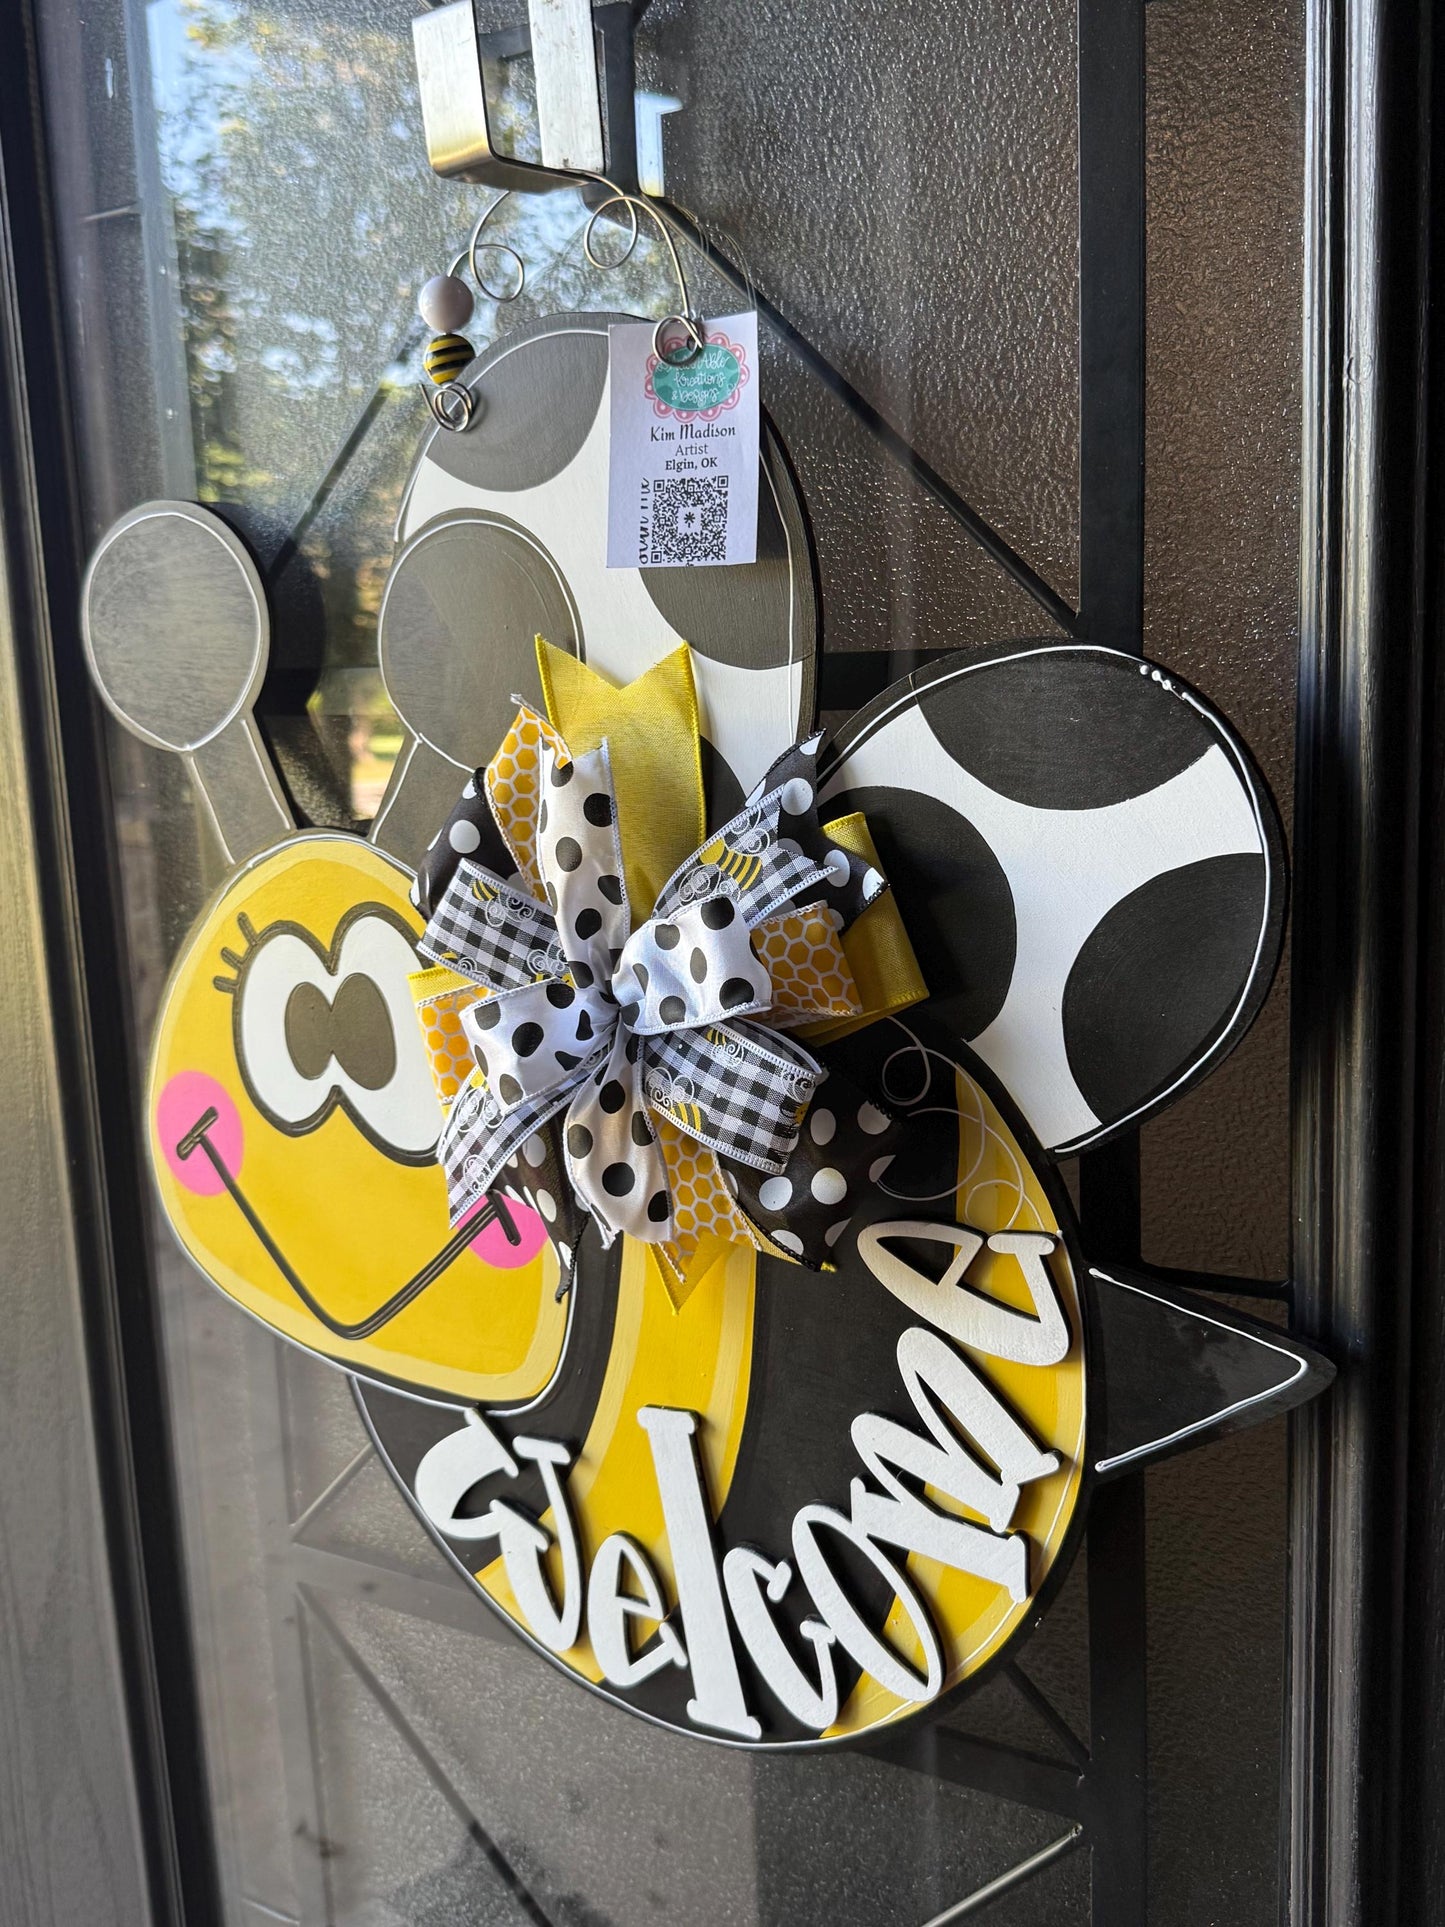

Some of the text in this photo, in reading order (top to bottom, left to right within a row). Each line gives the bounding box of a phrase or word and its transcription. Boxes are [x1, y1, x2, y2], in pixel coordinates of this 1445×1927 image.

[650, 423, 736, 442] Kim Madison
[675, 443, 710, 457] Artist
[665, 457, 718, 473] Elgin, OK
